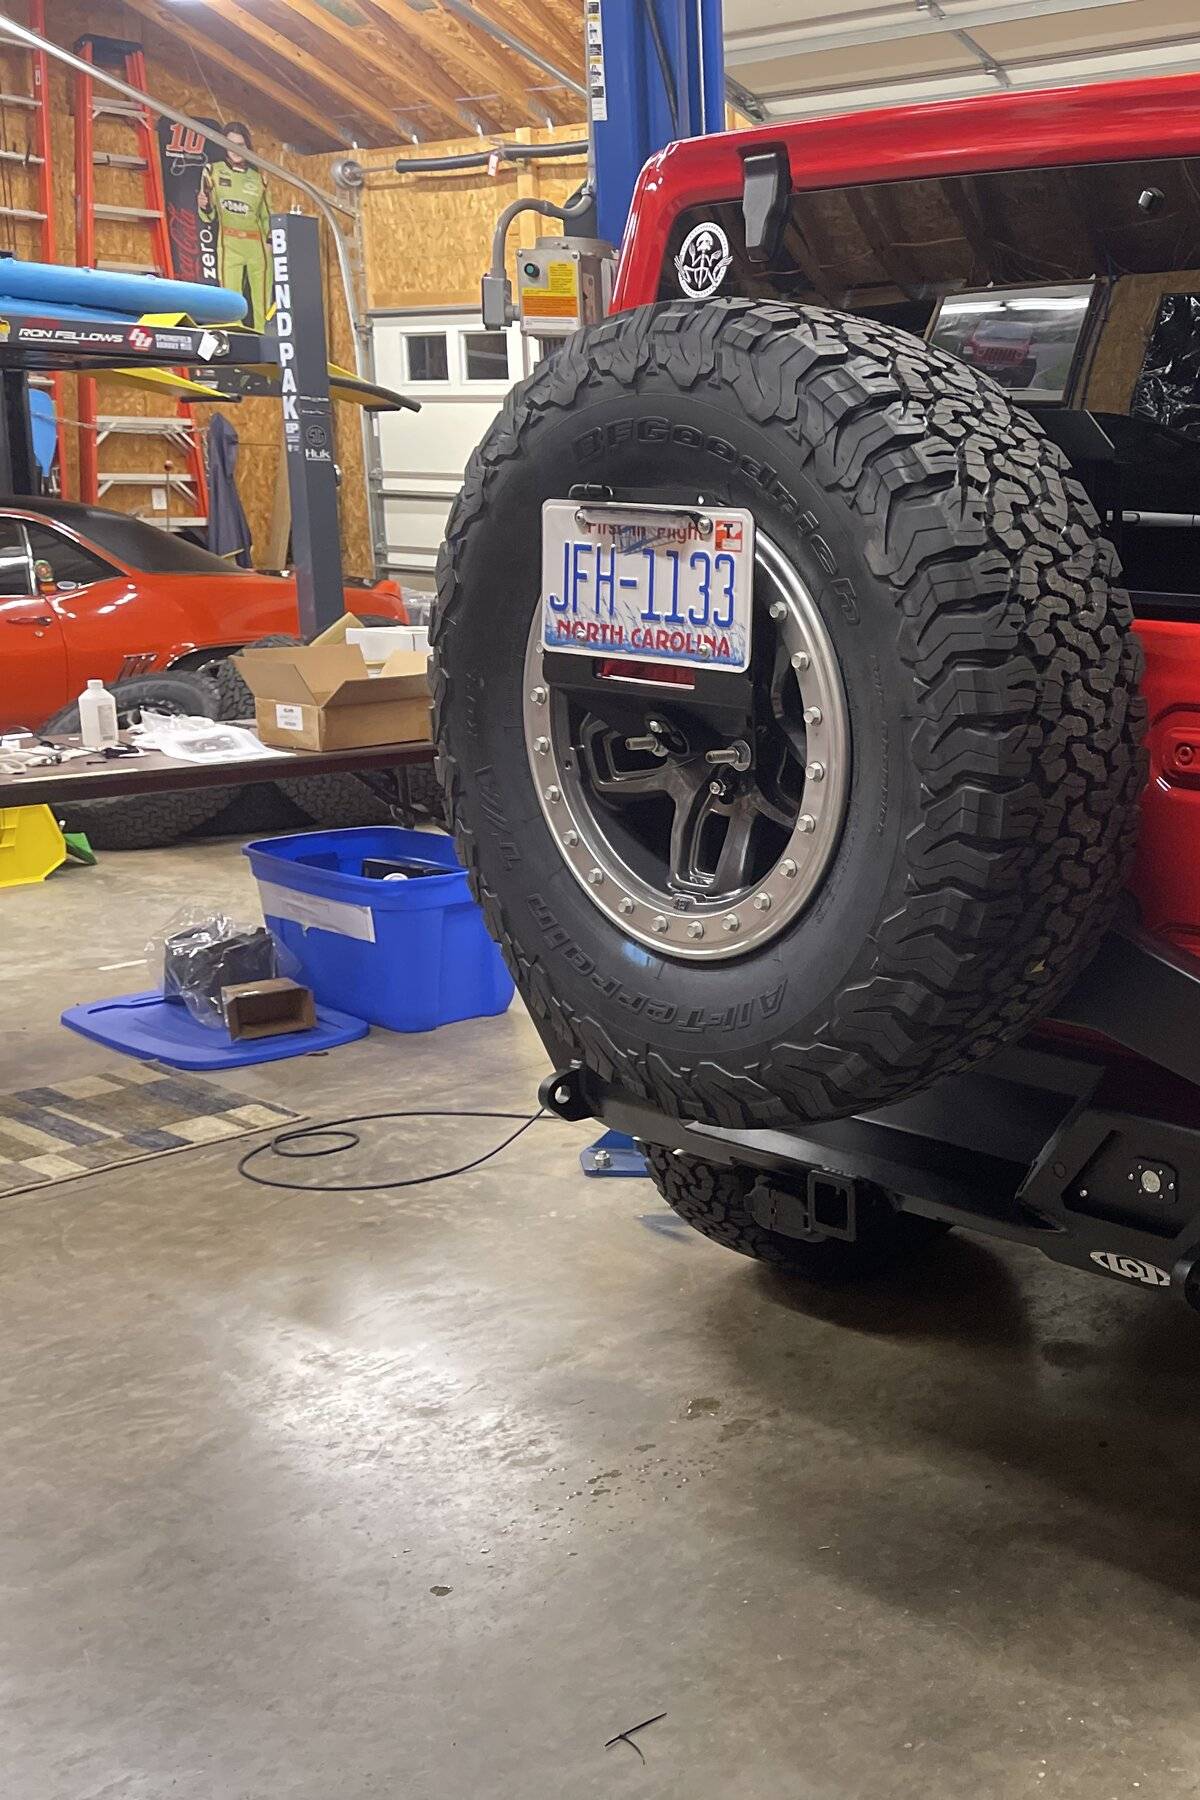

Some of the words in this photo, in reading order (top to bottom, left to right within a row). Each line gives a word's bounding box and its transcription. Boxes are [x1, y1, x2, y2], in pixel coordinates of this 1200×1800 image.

[166, 122, 206, 154] 10
[19, 328, 53, 338] RON
[549, 541, 735, 629] JFH-1133
[556, 618, 624, 646] NORTH
[630, 626, 731, 659] CAROLINA
